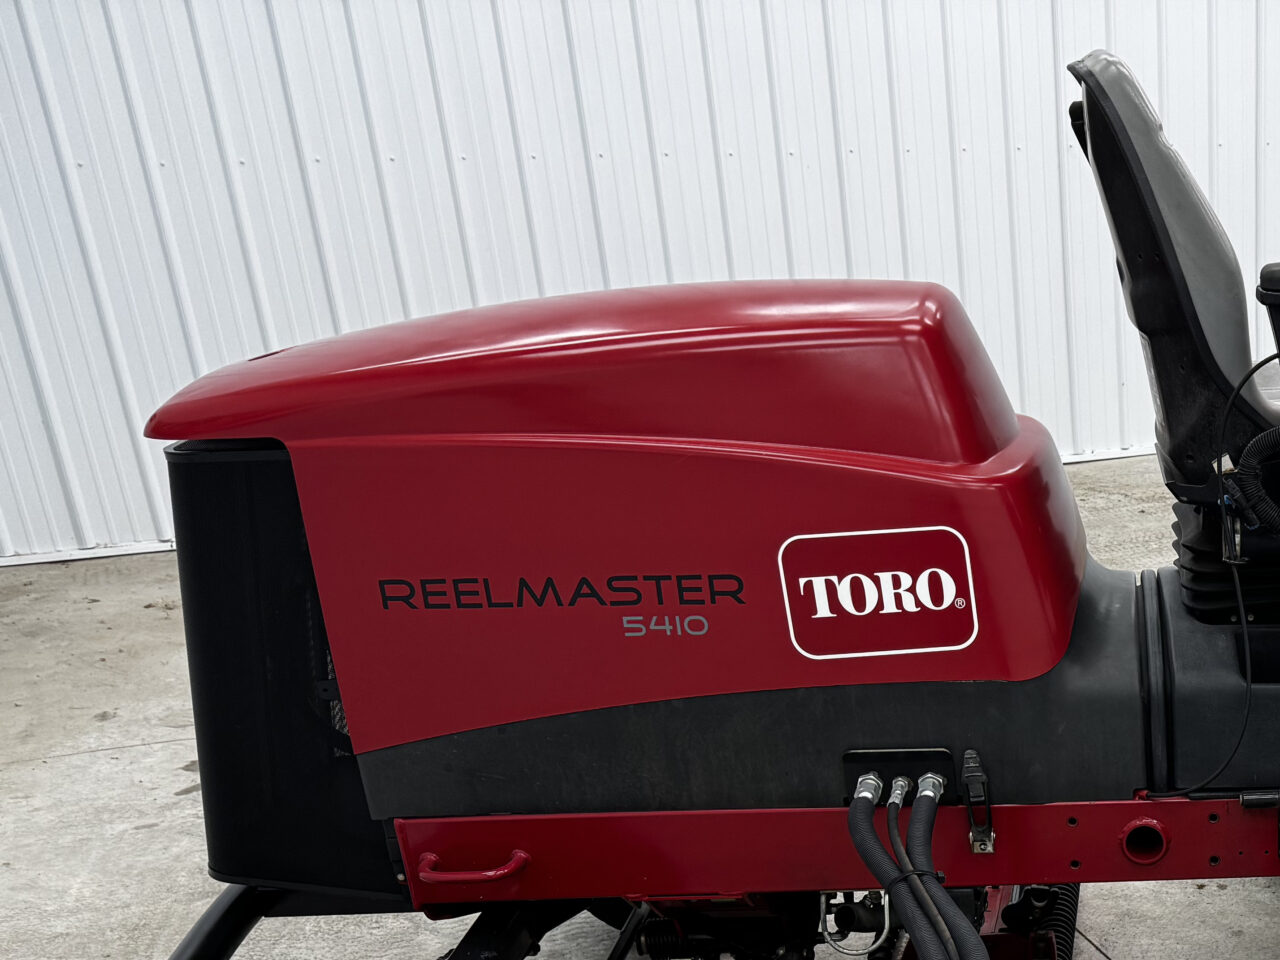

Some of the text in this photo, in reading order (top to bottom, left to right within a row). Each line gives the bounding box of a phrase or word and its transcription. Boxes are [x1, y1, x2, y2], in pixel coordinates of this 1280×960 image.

[378, 574, 746, 610] REELMASTER
[799, 567, 957, 619] TORO
[622, 615, 709, 637] 5410
